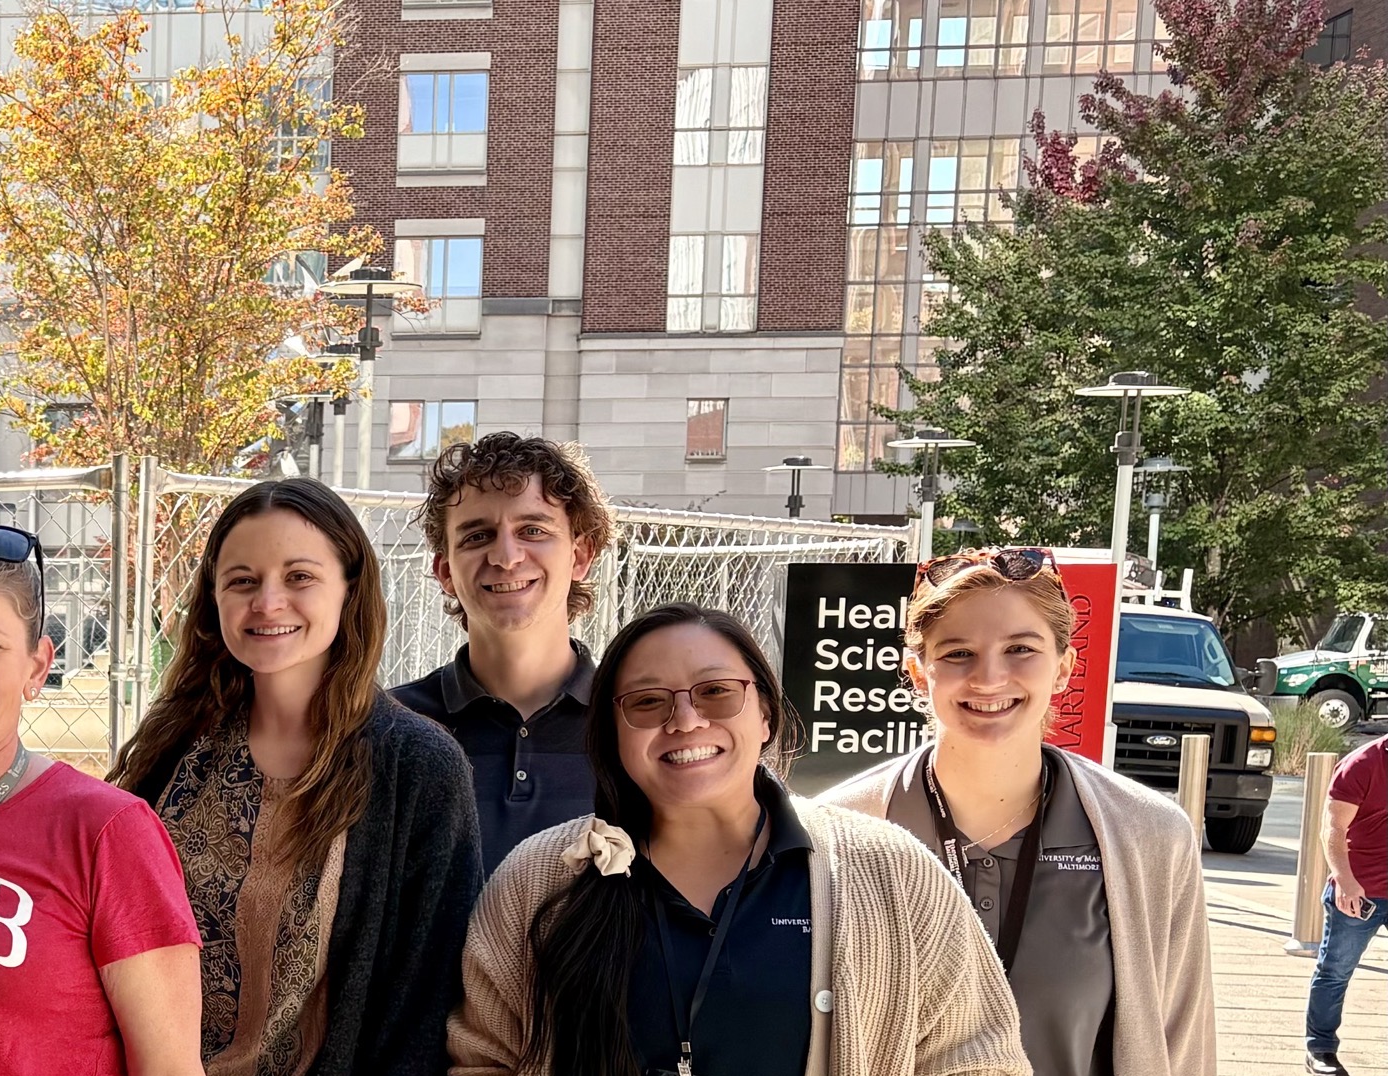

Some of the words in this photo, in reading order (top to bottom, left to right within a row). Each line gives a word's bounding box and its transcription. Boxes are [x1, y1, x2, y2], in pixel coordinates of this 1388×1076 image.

[817, 596, 908, 629] Heal
[813, 680, 932, 712] Resea
[812, 721, 933, 753] Facilit
[1038, 854, 1074, 862] IVERSITY
[1075, 854, 1084, 863] of
[1084, 854, 1101, 863] MAR
[771, 917, 810, 926] UNIVERSI
